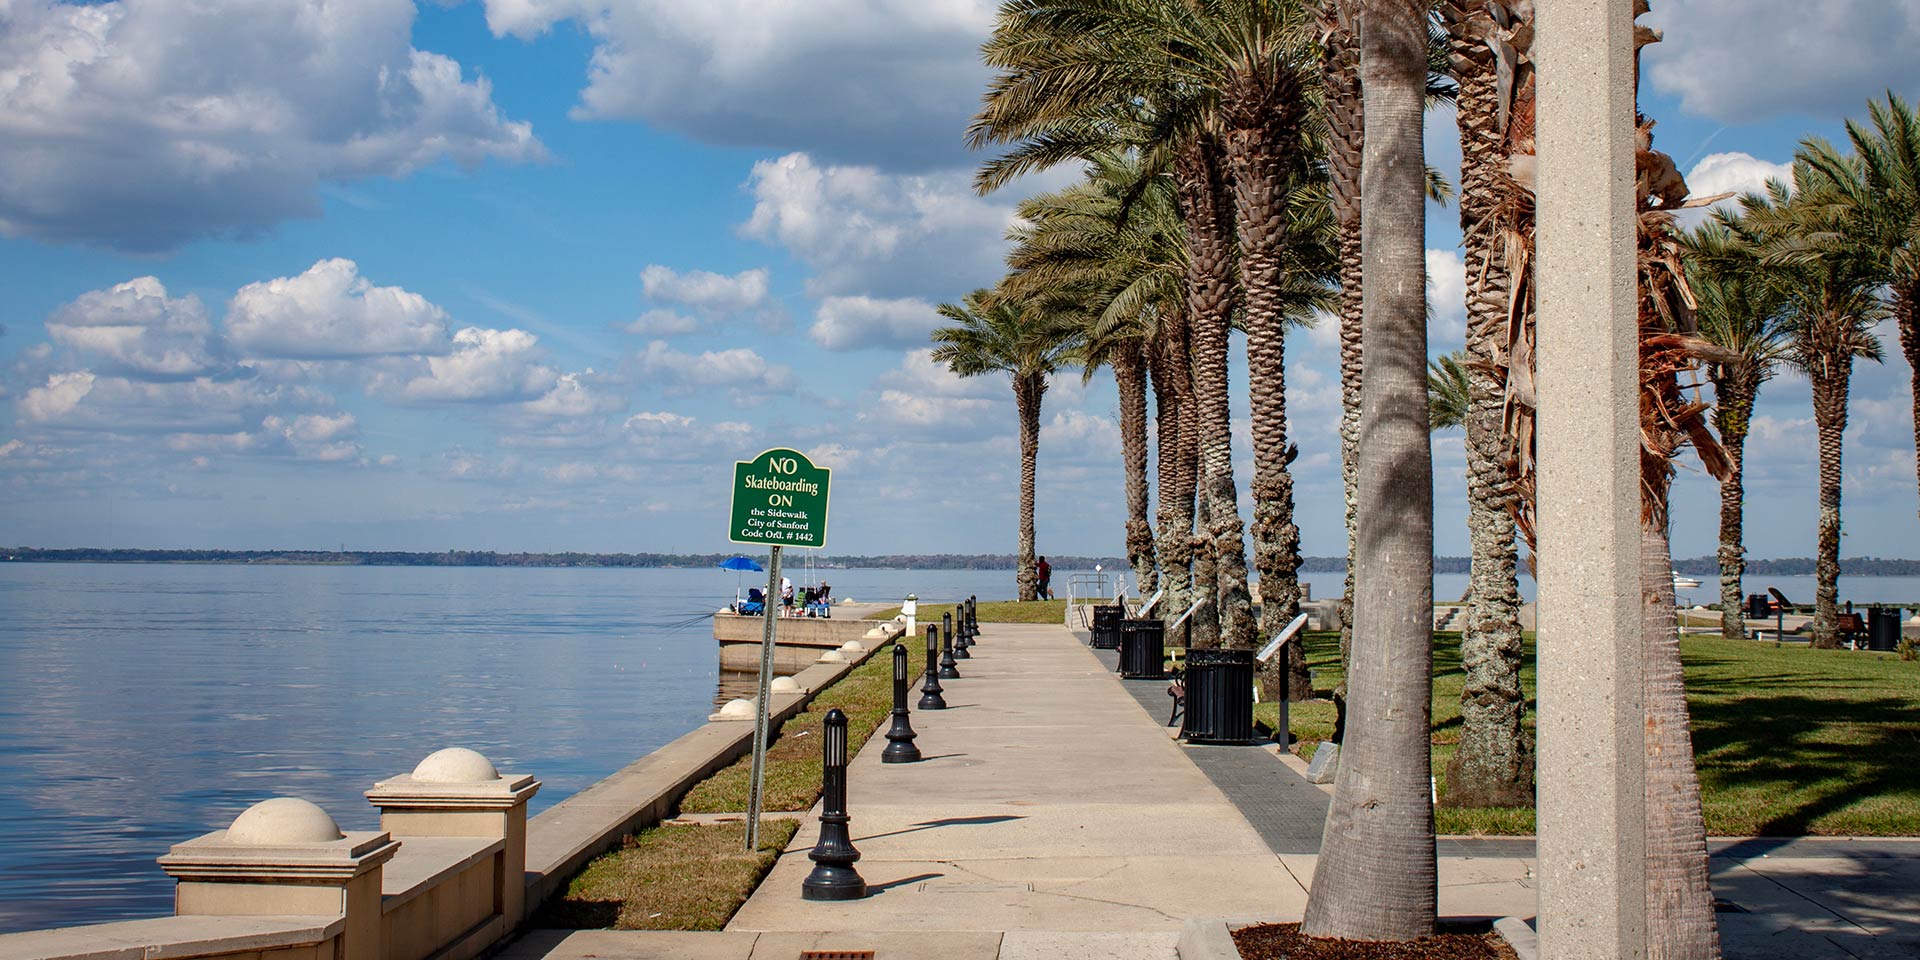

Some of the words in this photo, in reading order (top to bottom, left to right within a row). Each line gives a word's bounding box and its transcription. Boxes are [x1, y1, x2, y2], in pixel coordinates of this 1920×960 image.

[769, 457, 798, 475] NO
[745, 474, 818, 496] Skateboarding
[768, 494, 793, 507] ON
[751, 508, 765, 516] the
[767, 508, 808, 519] Sidewalk
[747, 518, 765, 529] City
[766, 519, 776, 527] of
[777, 520, 809, 530] Sanford
[741, 528, 763, 537] Code
[786, 531, 793, 540] #
[795, 532, 813, 541] 1442
